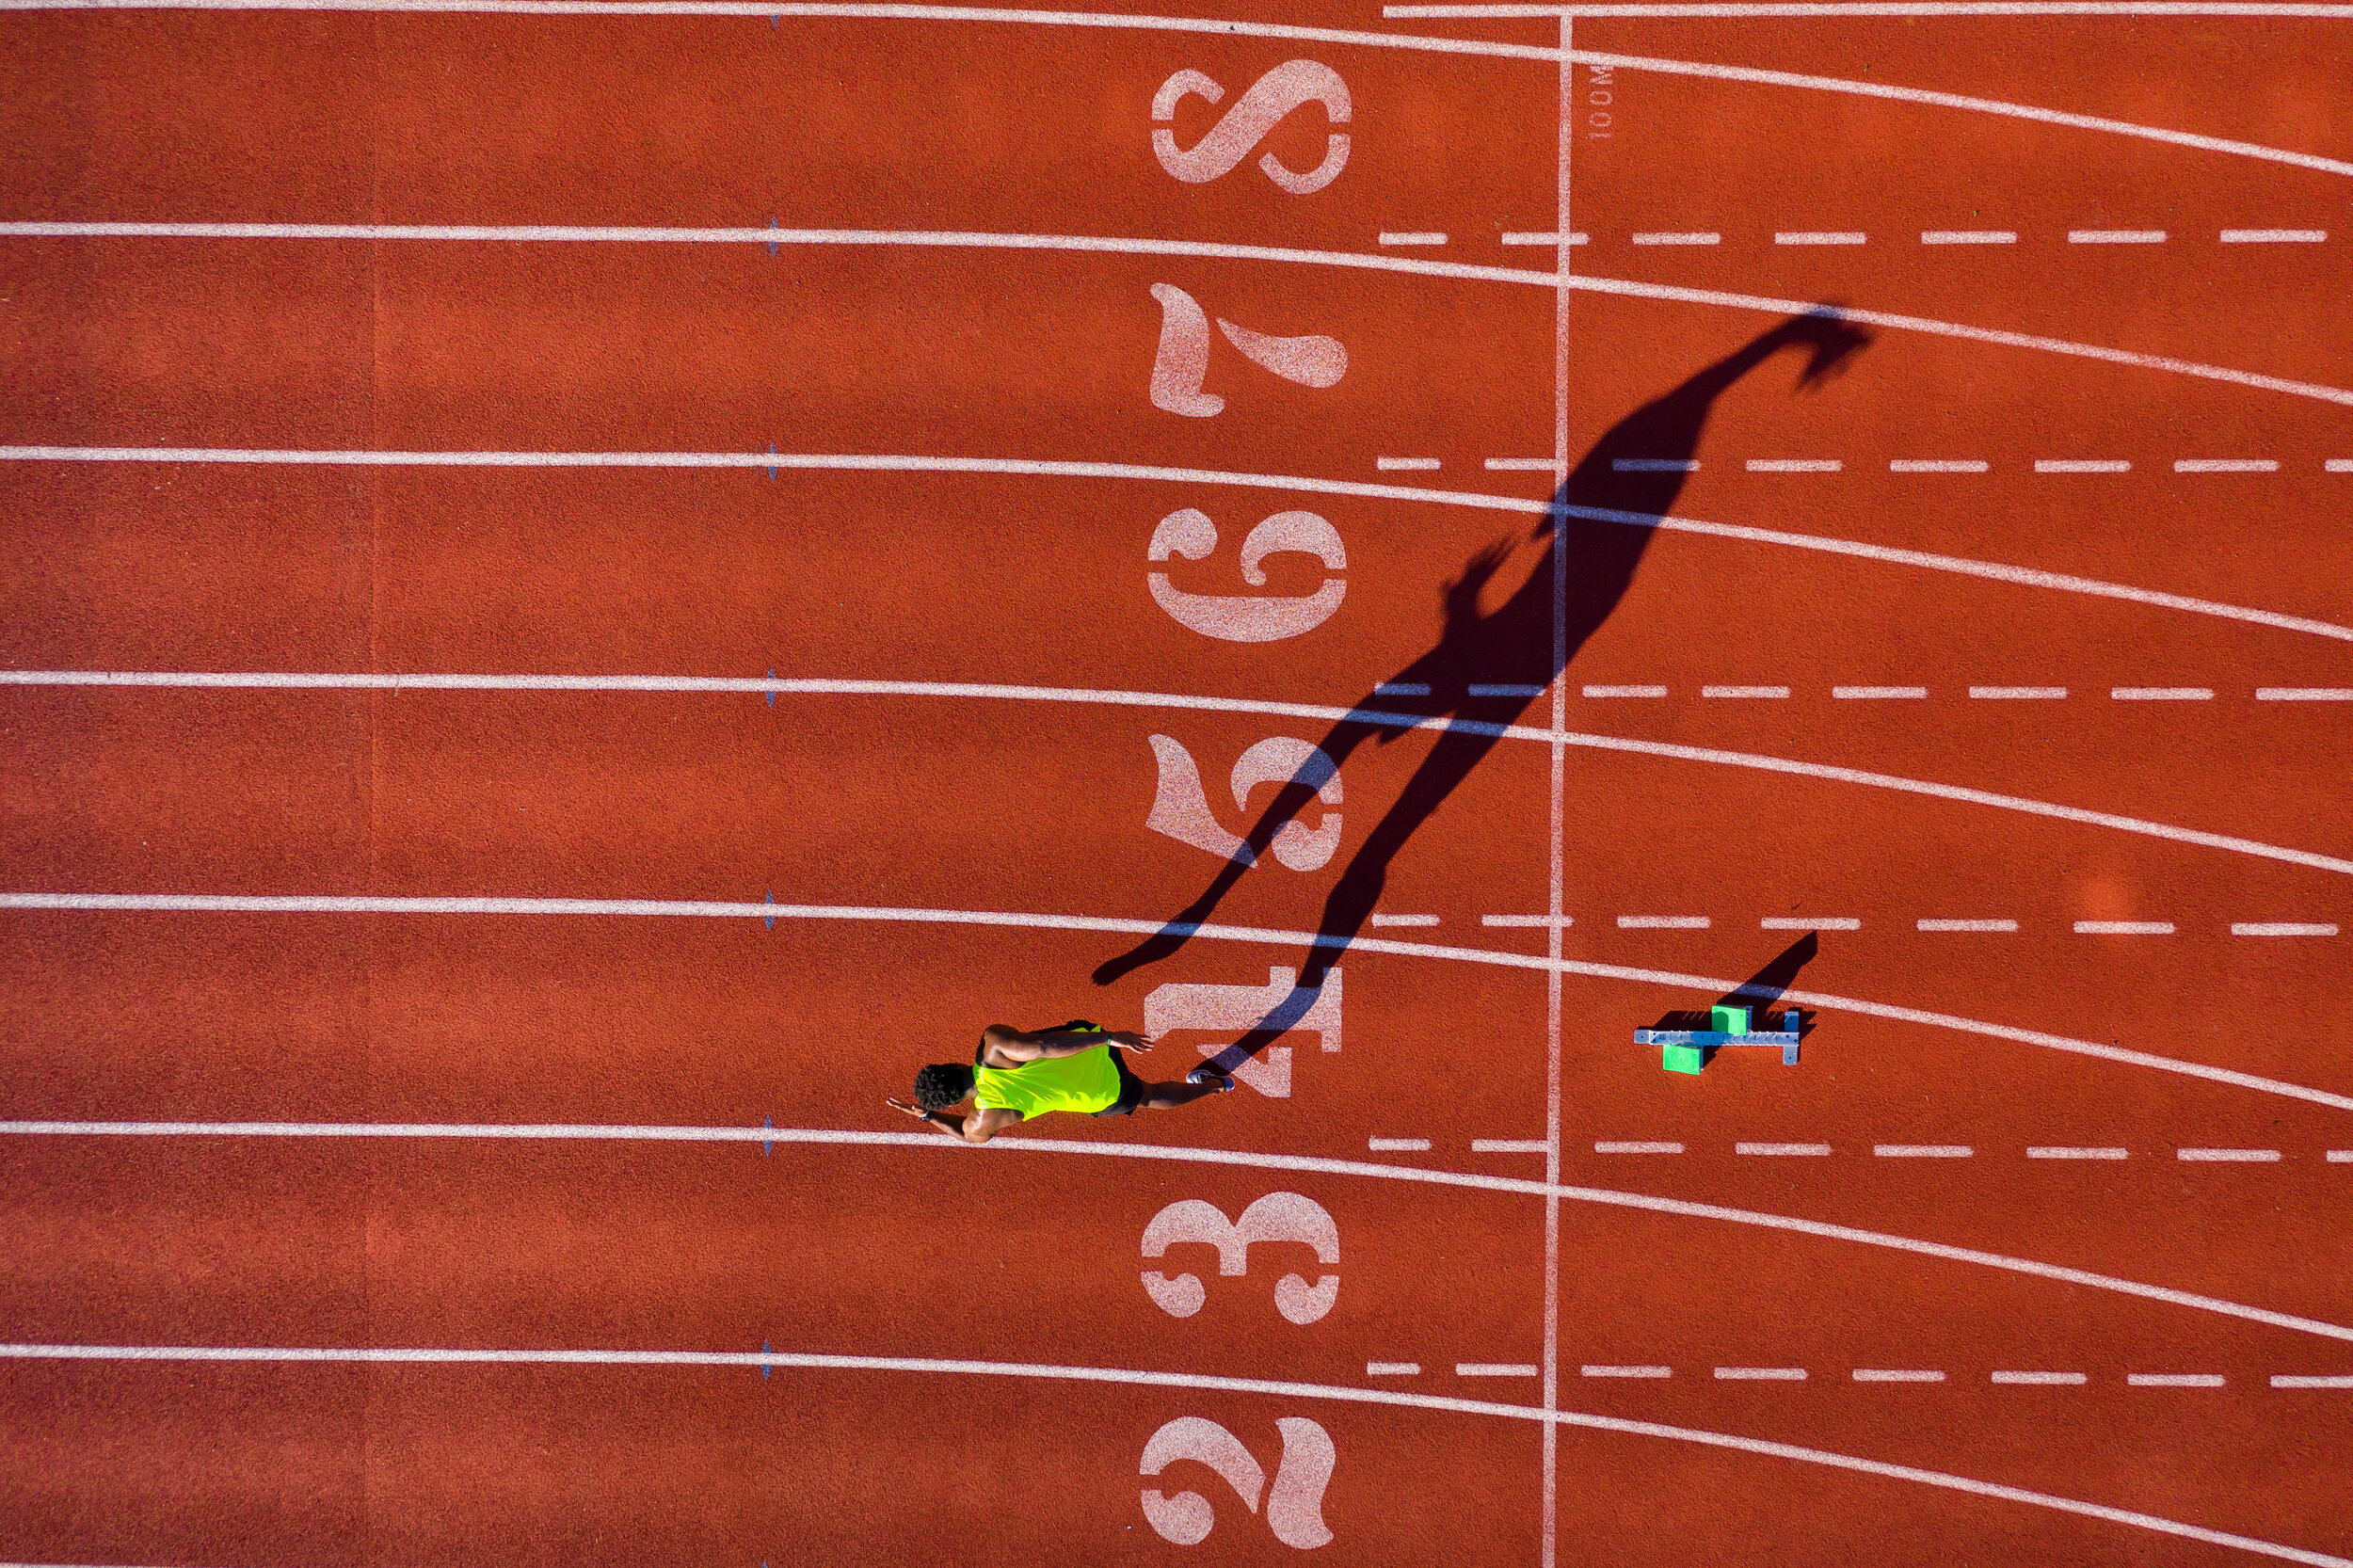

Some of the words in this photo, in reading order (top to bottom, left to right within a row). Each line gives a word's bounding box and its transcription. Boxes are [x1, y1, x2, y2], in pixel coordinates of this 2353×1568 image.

[1151, 59, 1353, 194] 8
[1149, 282, 1348, 418] 7
[1147, 507, 1347, 643] 6
[1145, 733, 1345, 872] 5
[1143, 964, 1344, 1098] 4
[1141, 1191, 1340, 1326] 3
[1139, 1416, 1337, 1549] 2
